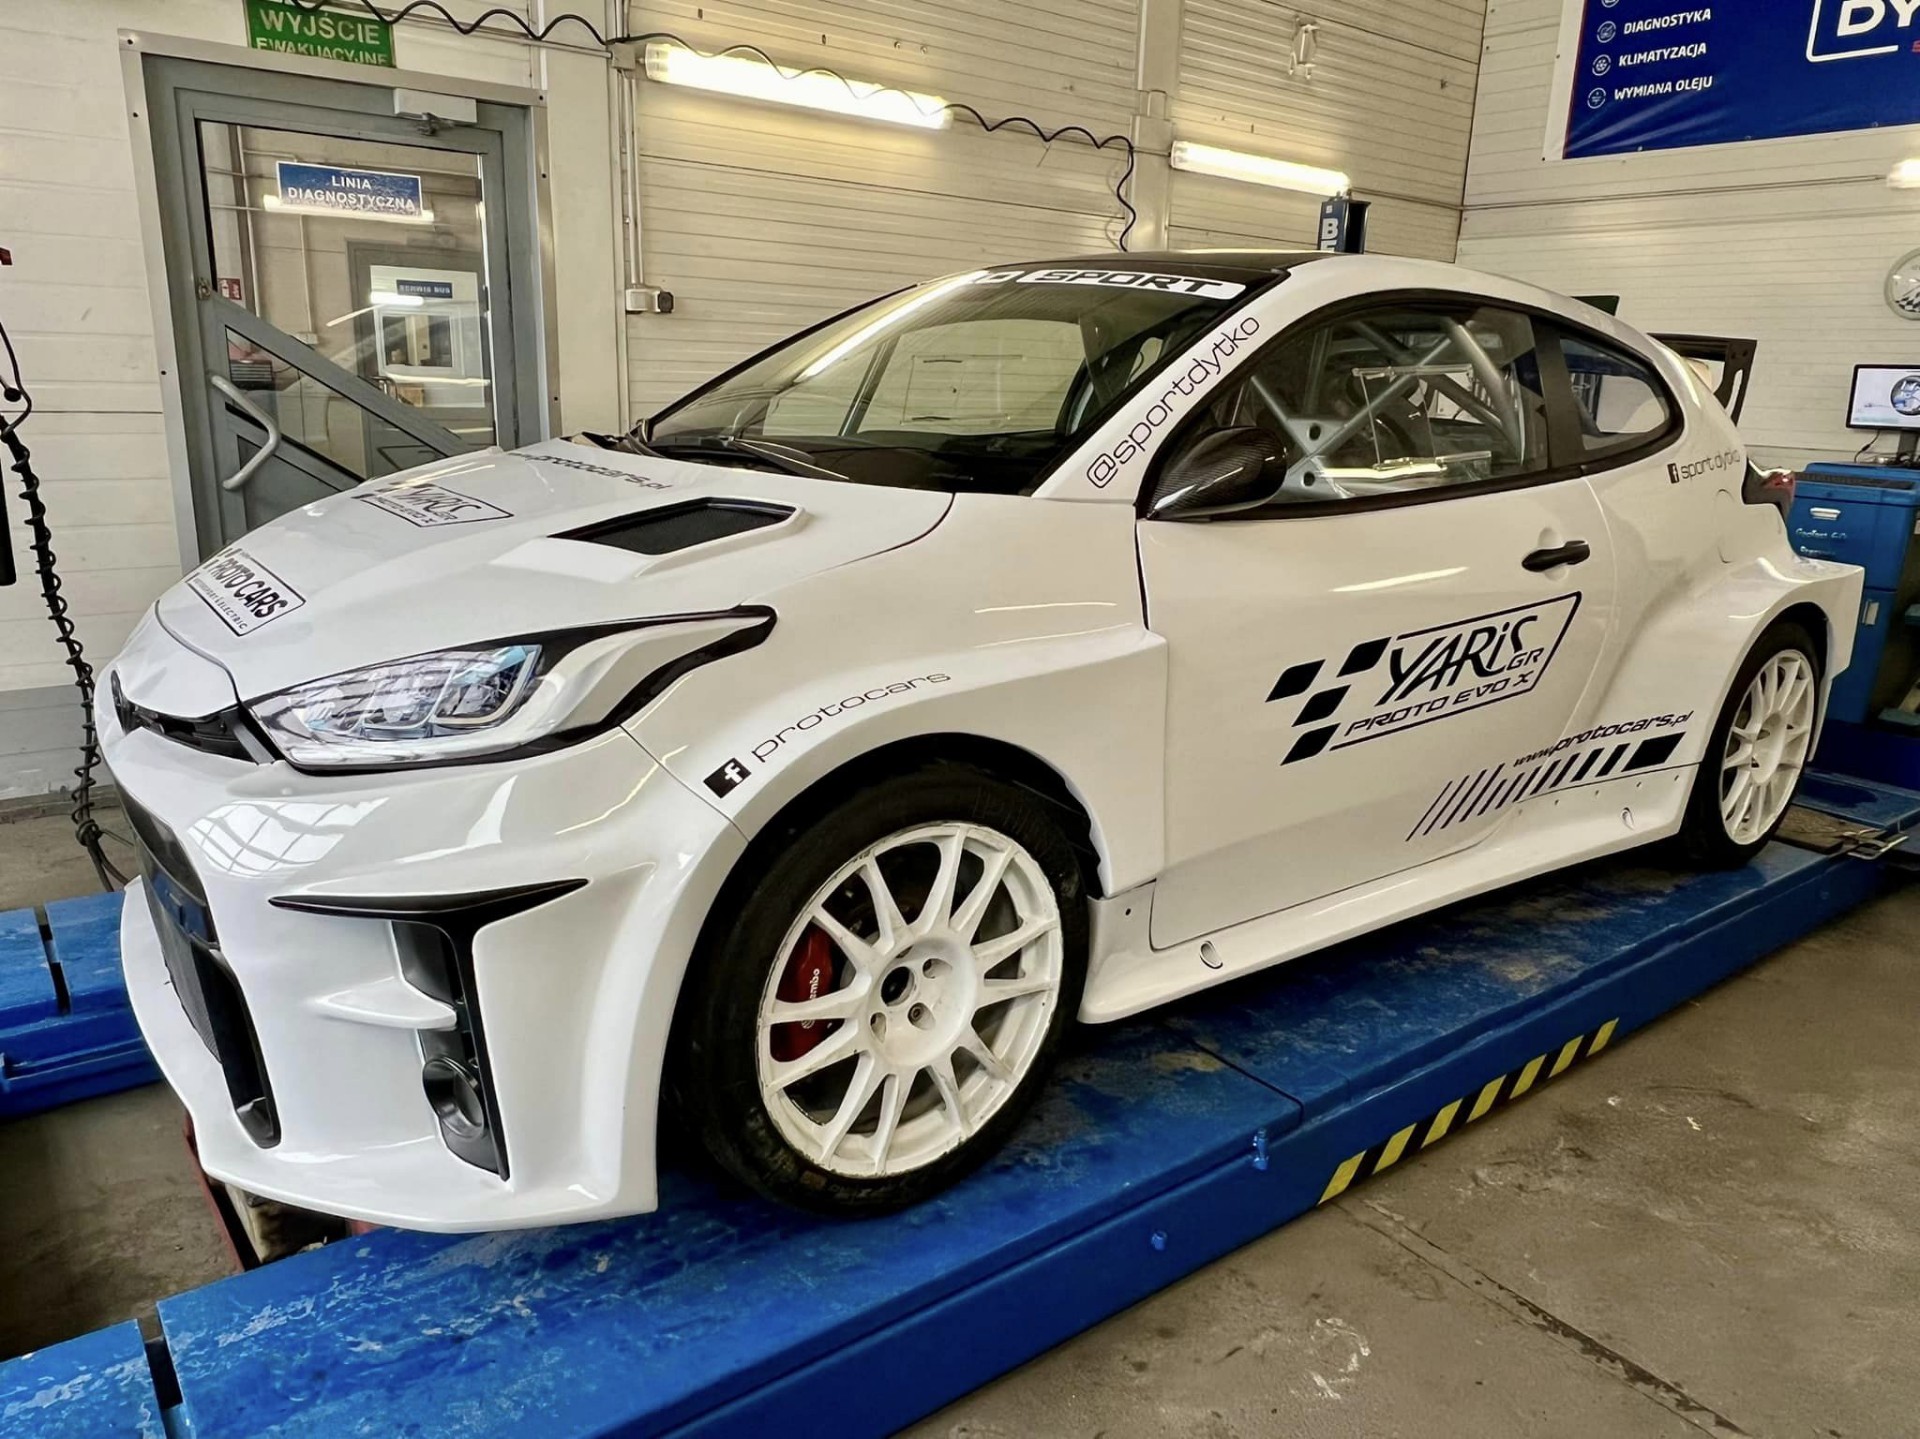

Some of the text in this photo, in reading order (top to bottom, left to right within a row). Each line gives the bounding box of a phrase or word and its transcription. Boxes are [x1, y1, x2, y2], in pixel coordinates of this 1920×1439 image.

[260, 9, 380, 45] WYJŚCIE
[1623, 8, 1711, 34] DIAGNOSTYKA
[1618, 42, 1706, 67] KLIMATYZACJA
[1614, 75, 1713, 100] WYMIANA OLEJU
[332, 175, 372, 190] LINIA
[287, 186, 416, 211] DIAGNOSTYCZNA
[1042, 270, 1225, 292] SPORT
[1086, 316, 1260, 489] @sportdytko
[1506, 647, 1546, 672] GR
[751, 672, 952, 764] protocars
[1344, 694, 1451, 737] PROTO
[1452, 677, 1511, 706] EVO
